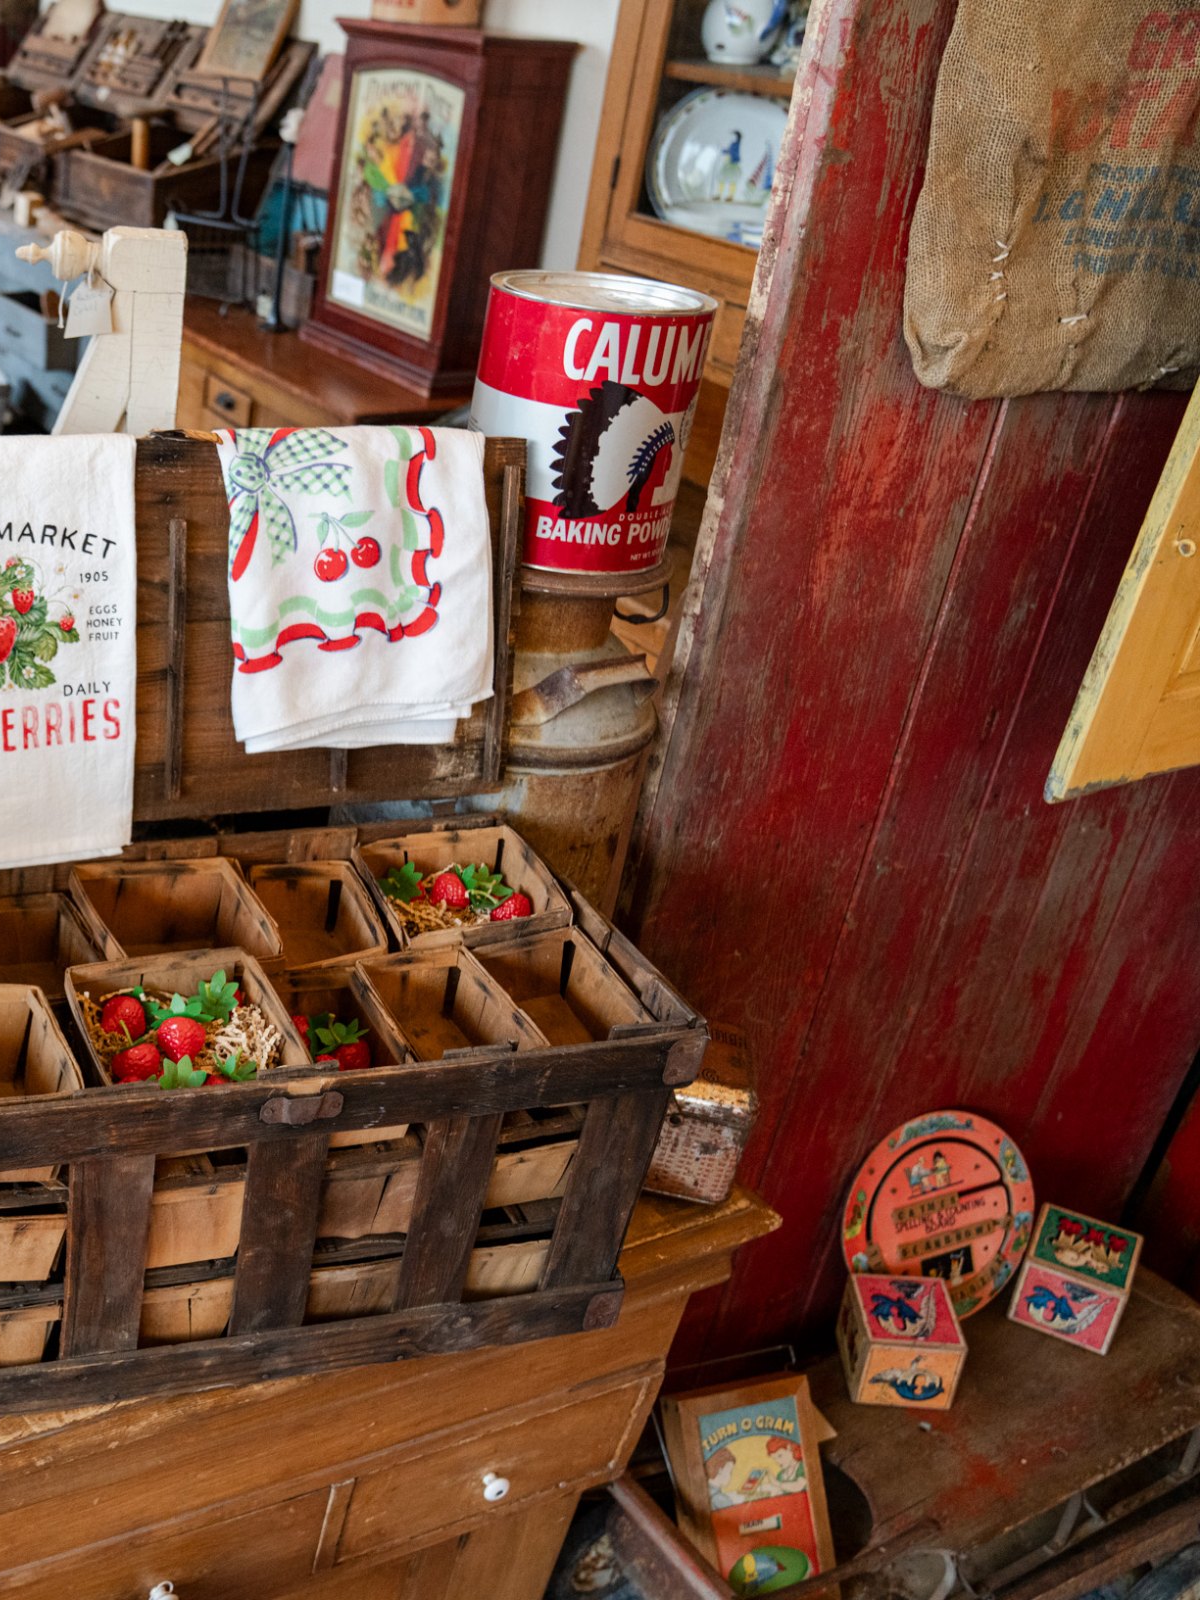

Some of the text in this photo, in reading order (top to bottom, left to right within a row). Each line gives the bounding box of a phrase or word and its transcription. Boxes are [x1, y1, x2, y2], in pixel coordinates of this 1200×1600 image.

[536, 516, 622, 546] BAKING
[79, 571, 109, 583] 1905
[88, 604, 118, 615] EGGS
[86, 618, 122, 629] HONEY
[88, 632, 120, 641] FRUIT
[63, 681, 111, 697] DAILY
[702, 1414, 795, 1451] TURN O GRAM
